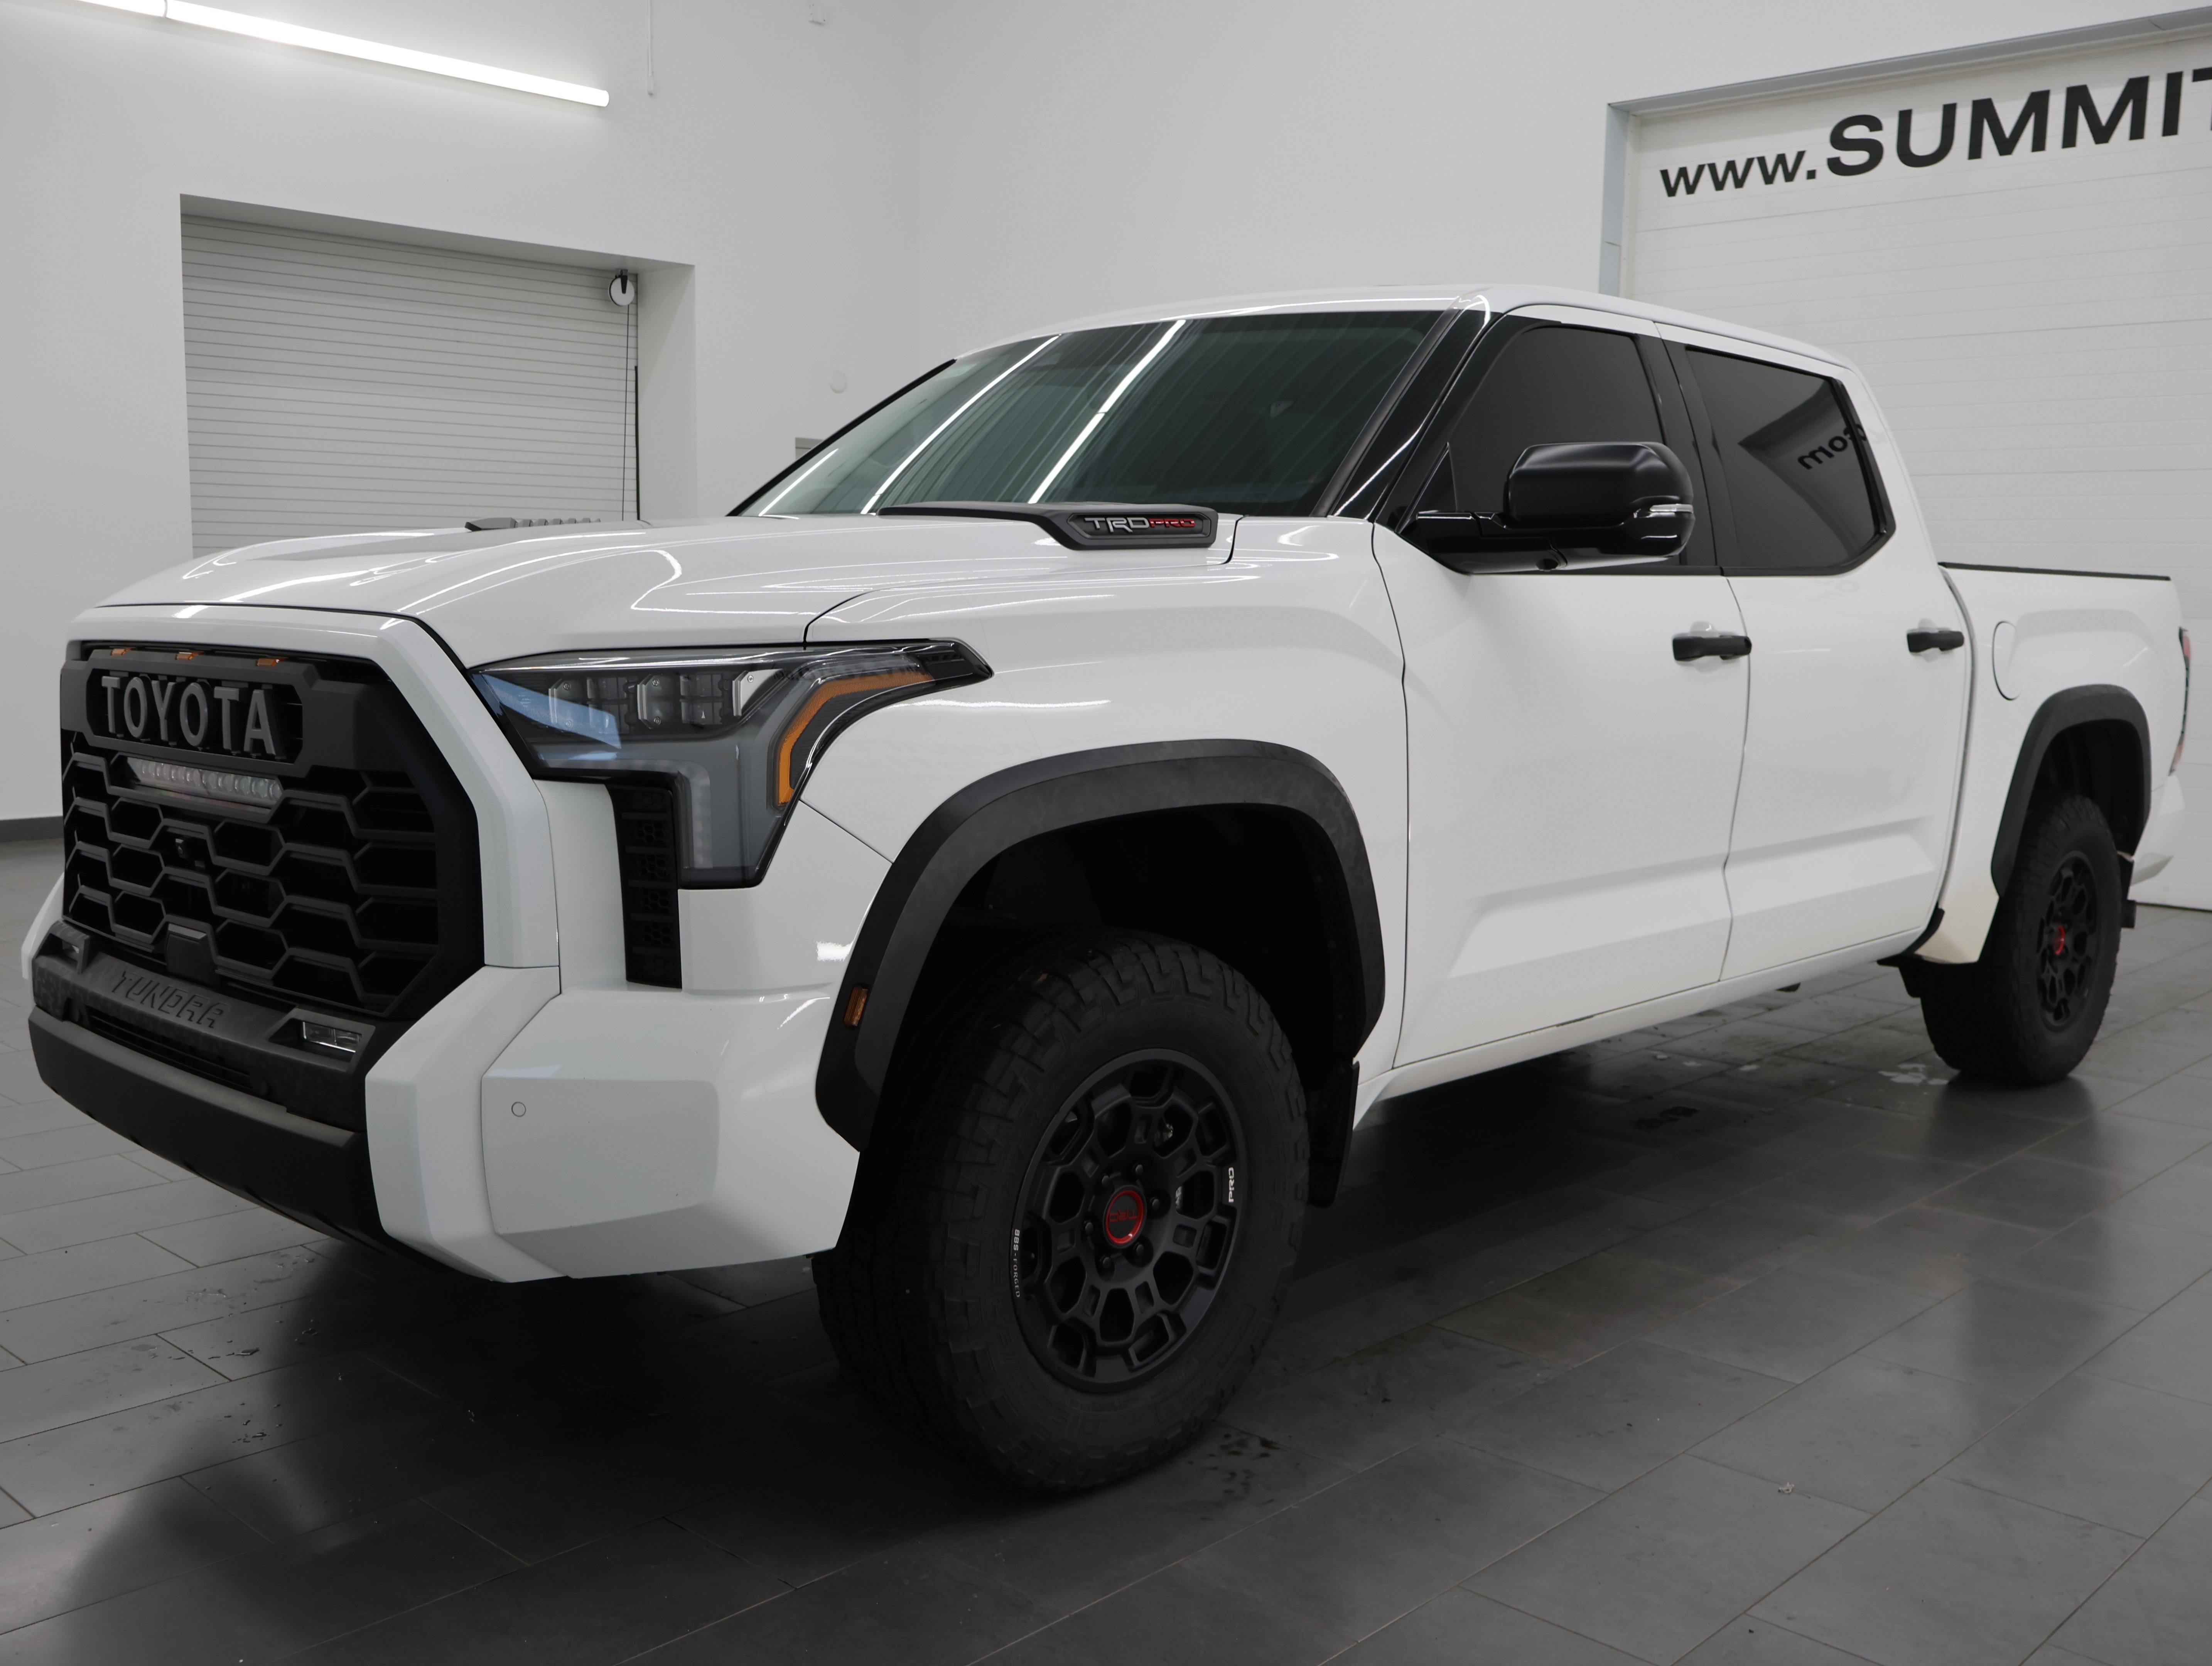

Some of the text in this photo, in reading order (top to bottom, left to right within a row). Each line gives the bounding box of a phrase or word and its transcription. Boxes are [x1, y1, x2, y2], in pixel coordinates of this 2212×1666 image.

[1084, 517, 1196, 533] TRD PRO
[101, 675, 278, 757] TOYOTA
[110, 970, 230, 1029] TUNDRA
[1109, 1207, 1138, 1223] TRD
